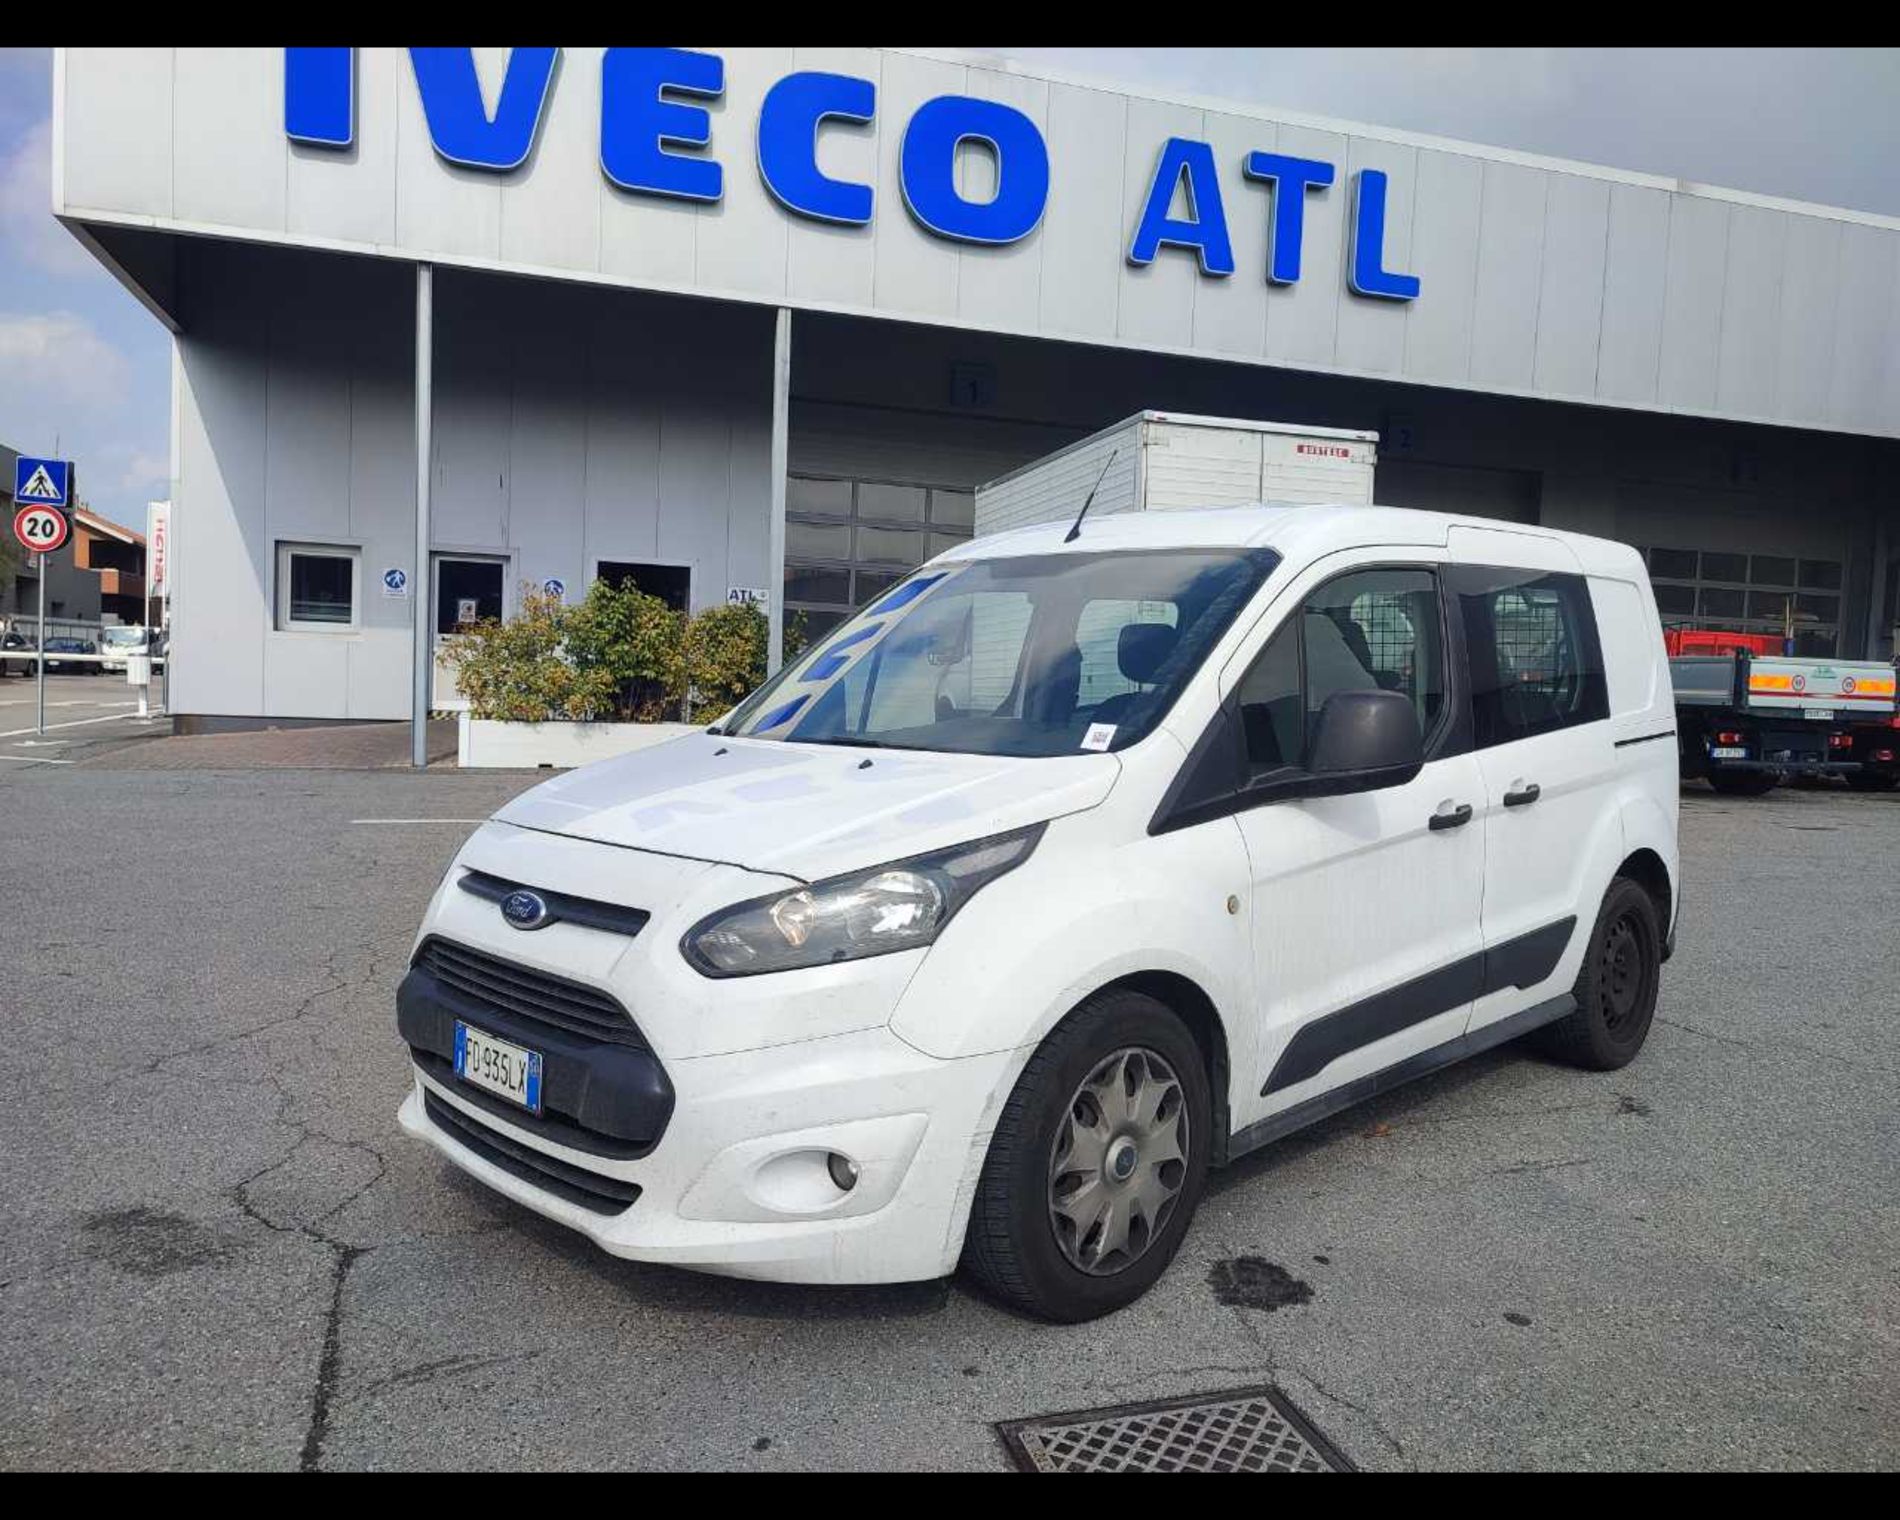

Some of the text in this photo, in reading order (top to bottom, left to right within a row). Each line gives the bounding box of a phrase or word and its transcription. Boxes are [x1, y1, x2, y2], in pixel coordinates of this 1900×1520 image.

[284, 47, 1422, 302] IVECO ATL
[27, 517, 55, 538] 20
